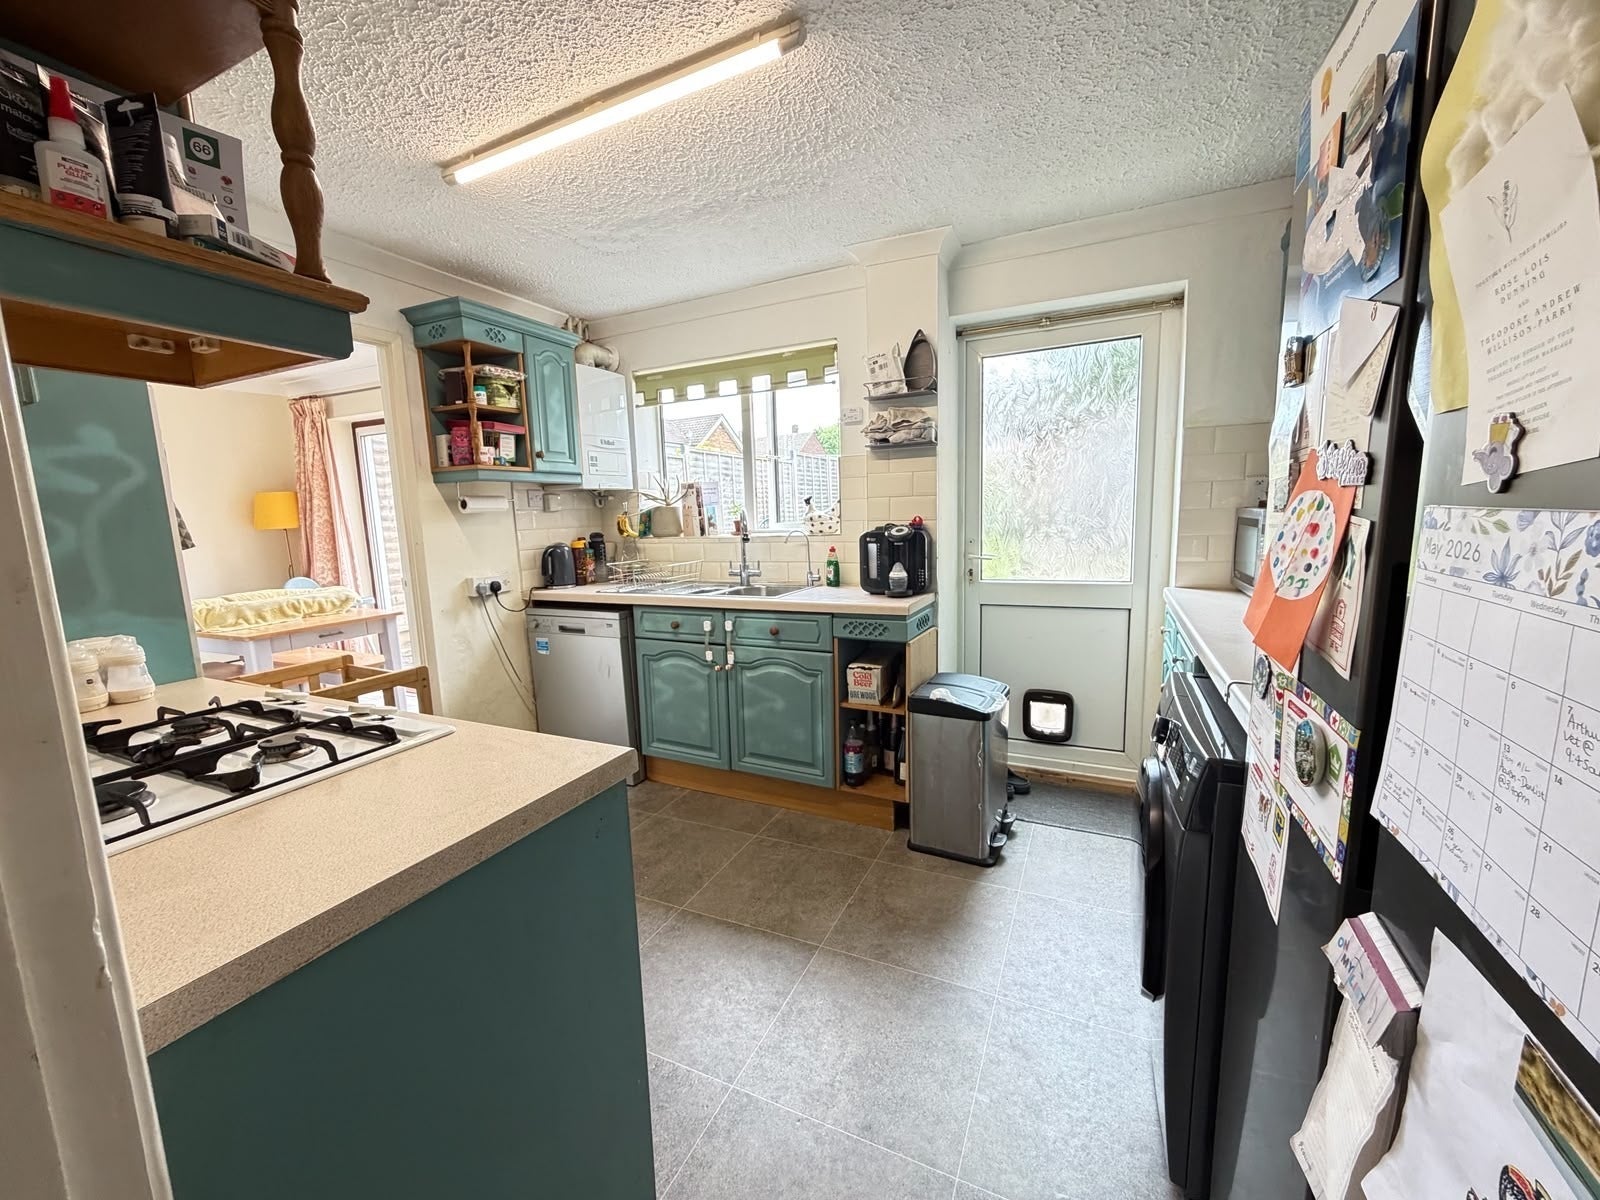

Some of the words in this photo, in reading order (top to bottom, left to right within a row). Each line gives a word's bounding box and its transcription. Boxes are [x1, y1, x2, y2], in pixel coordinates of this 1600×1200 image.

[191, 141, 212, 156] 66
[57, 162, 93, 178] PLASTIC
[65, 170, 89, 182] GLUE
[1494, 274, 1519, 296] ROSE
[1525, 252, 1550, 276] LOIS
[1500, 270, 1546, 305] DUNNING
[1480, 314, 1529, 347] THEODORE
[1535, 282, 1582, 316] ANDREW
[1487, 302, 1574, 356] WILLISON-PARRY
[1424, 536, 1443, 561] May
[1445, 539, 1481, 563] 2026
[1452, 581, 1473, 593] Monday
[1492, 590, 1515, 604] Tuesday
[1530, 599, 1569, 618] Wednesday
[1589, 614, 1600, 625] Th
[853, 671, 872, 680] Cold
[853, 679, 873, 688] Beer
[850, 690, 876, 700] BREWDOG
[1567, 705, 1574, 715] 7
[1463, 718, 1470, 728] 12
[1566, 713, 1600, 742] Arthu
[1503, 743, 1511, 753] 13
[1582, 739, 1595, 757] @
[1565, 747, 1600, 777] 9:45a
[1456, 772, 1463, 782] 19
[1554, 774, 1563, 785] 14
[1494, 803, 1503, 814] 20
[1447, 825, 1455, 836] 26
[1542, 841, 1552, 854] 21
[1483, 860, 1493, 872] 27
[1529, 905, 1541, 919] 28
[1340, 953, 1355, 973] MY
